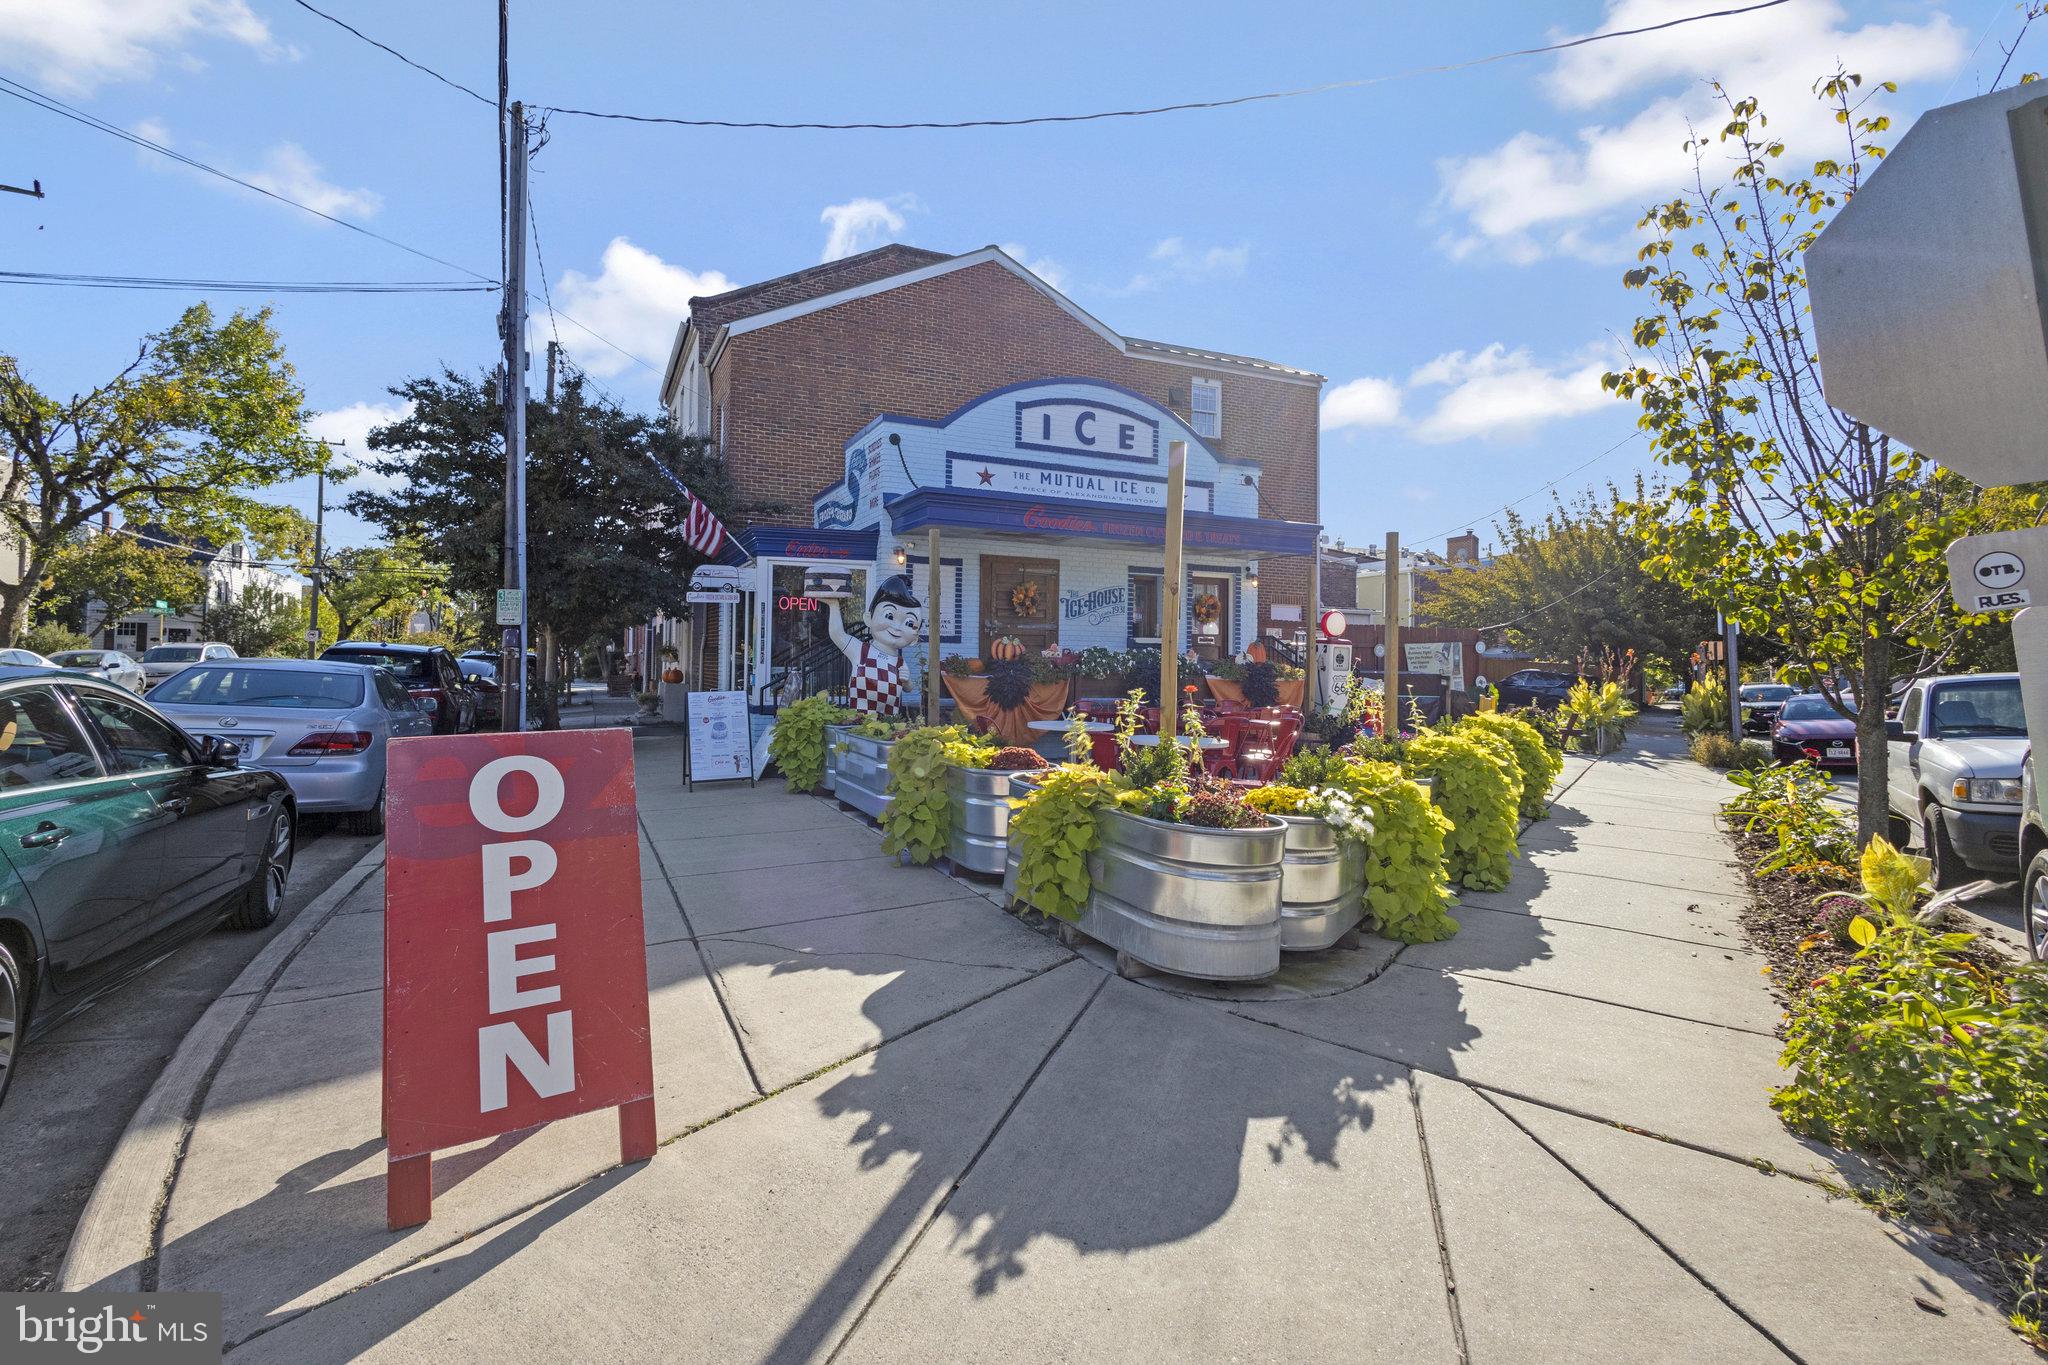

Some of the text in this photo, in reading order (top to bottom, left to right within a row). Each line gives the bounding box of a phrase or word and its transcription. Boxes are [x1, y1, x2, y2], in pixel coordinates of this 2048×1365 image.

[1043, 411, 1134, 449] ICE
[1013, 471, 1159, 495] THE MUTUAL ICE CO.
[1064, 491, 1123, 501] ALEXANDRIA'S
[1126, 496, 1159, 504] HISTORY
[779, 596, 818, 611] OPEN
[1084, 588, 1125, 611] HOUSE
[1978, 592, 2026, 608] RUES.
[469, 755, 576, 1114] OPEN
